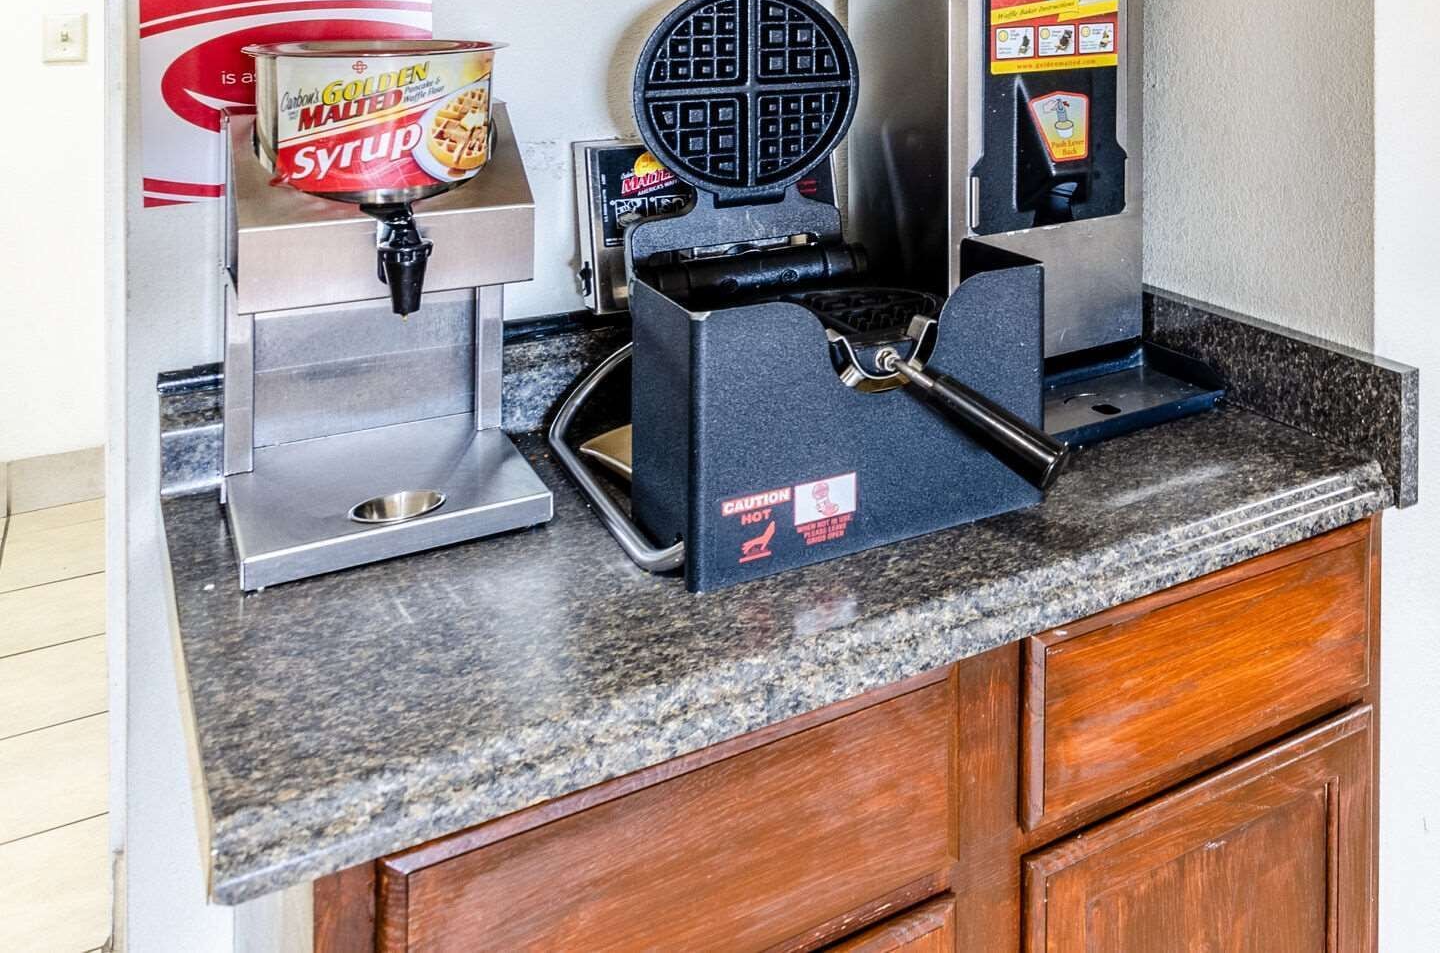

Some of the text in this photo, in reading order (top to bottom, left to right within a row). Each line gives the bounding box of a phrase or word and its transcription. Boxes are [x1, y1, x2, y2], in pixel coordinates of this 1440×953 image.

[221, 70, 237, 85] is
[280, 61, 431, 112] Carbon's GOLDEN
[298, 89, 404, 132] MALTED
[292, 122, 423, 180] Syrup
[723, 488, 791, 515] CAUTION
[741, 509, 773, 525] HOT
